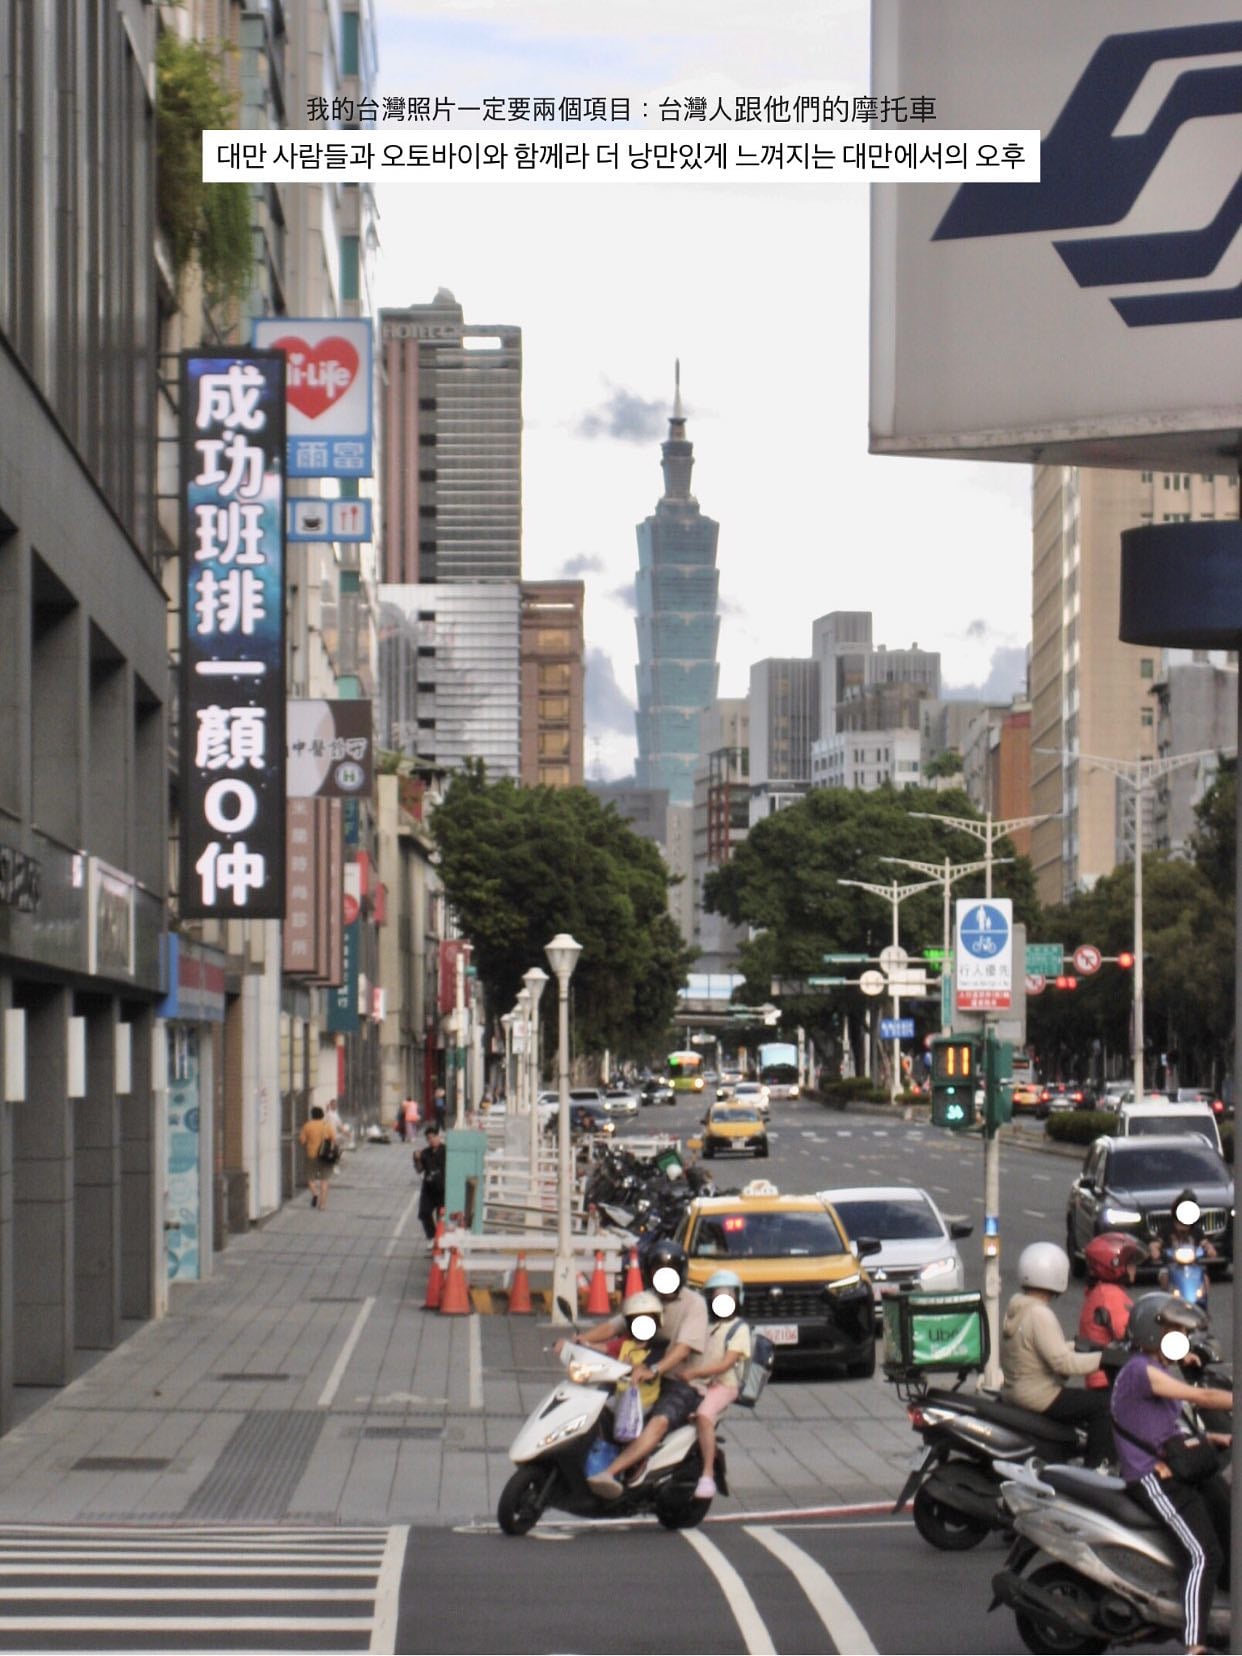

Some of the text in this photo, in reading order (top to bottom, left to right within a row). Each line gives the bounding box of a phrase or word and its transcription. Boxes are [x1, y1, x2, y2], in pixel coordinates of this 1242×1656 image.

[286, 441, 365, 469] 爾富
[959, 963, 1010, 977] 行人優先
[946, 1046, 970, 1076] 11
